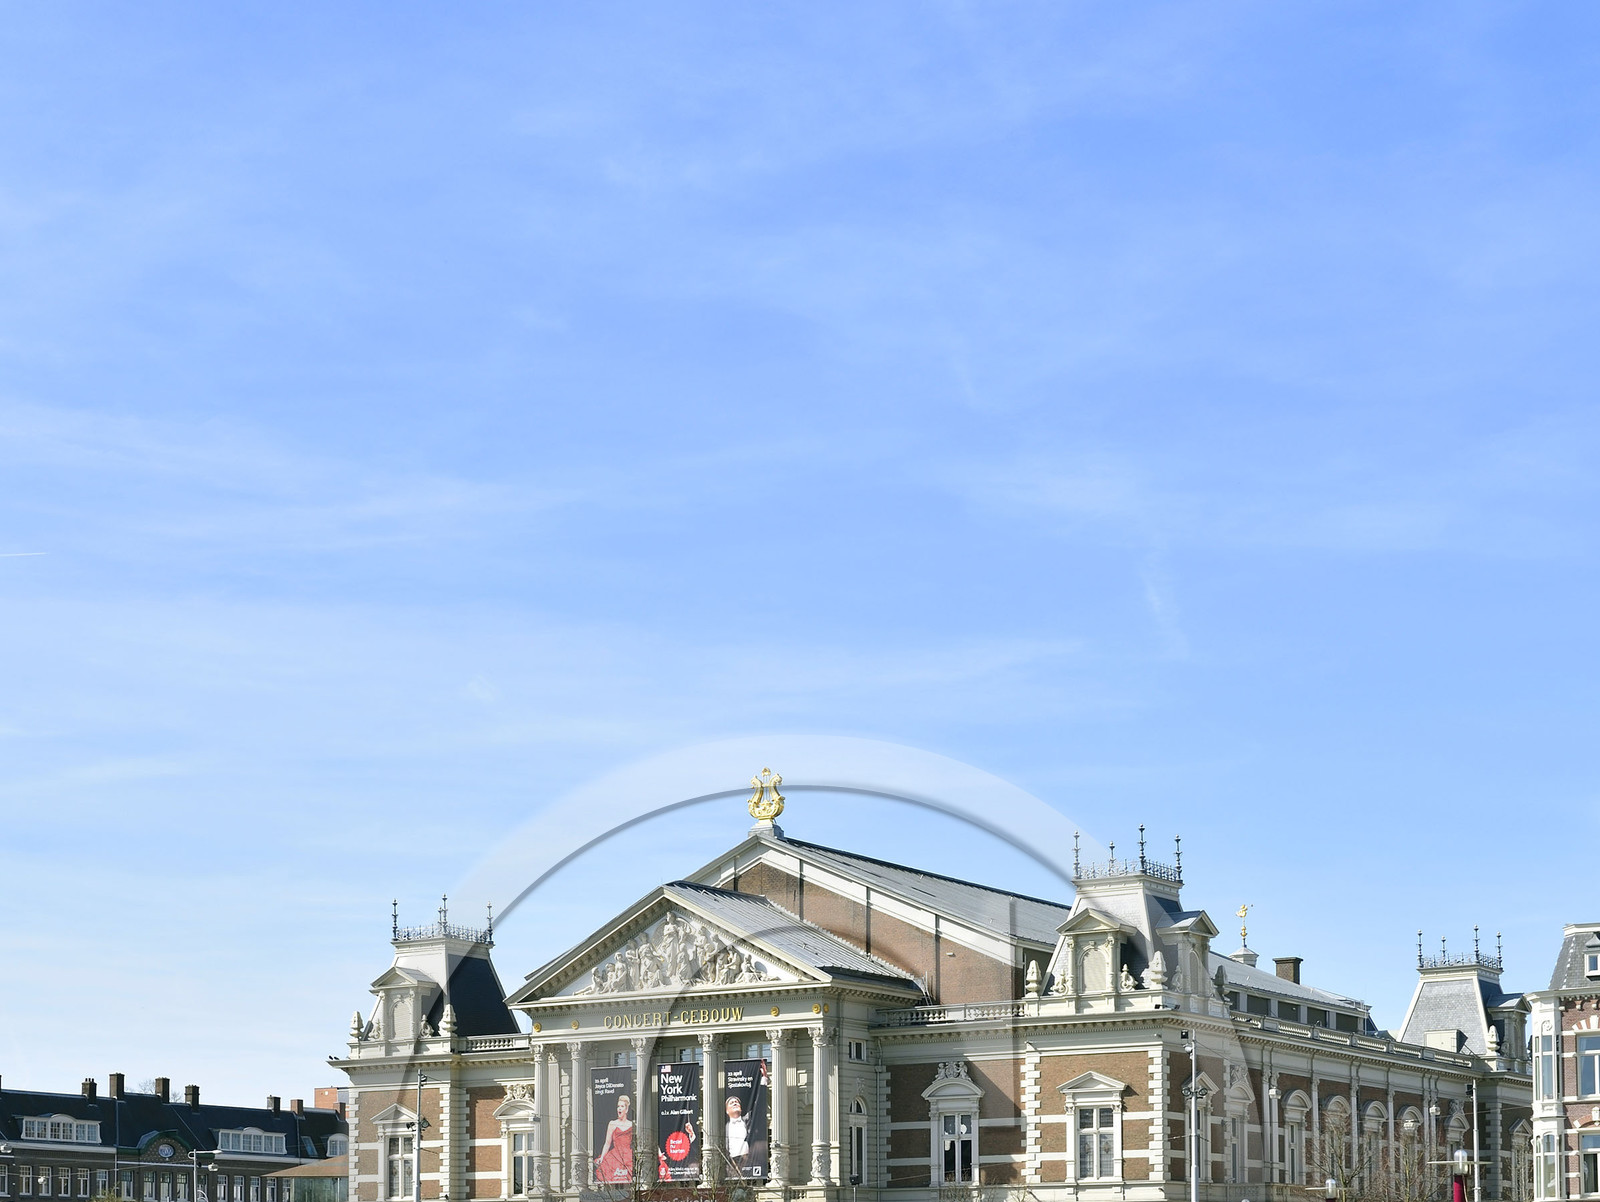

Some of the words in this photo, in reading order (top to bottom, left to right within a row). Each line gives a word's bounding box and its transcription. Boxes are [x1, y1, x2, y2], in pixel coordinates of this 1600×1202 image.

[660, 1073, 683, 1084] New
[660, 1083, 683, 1095] York
[660, 1094, 698, 1102] Philharmonic
